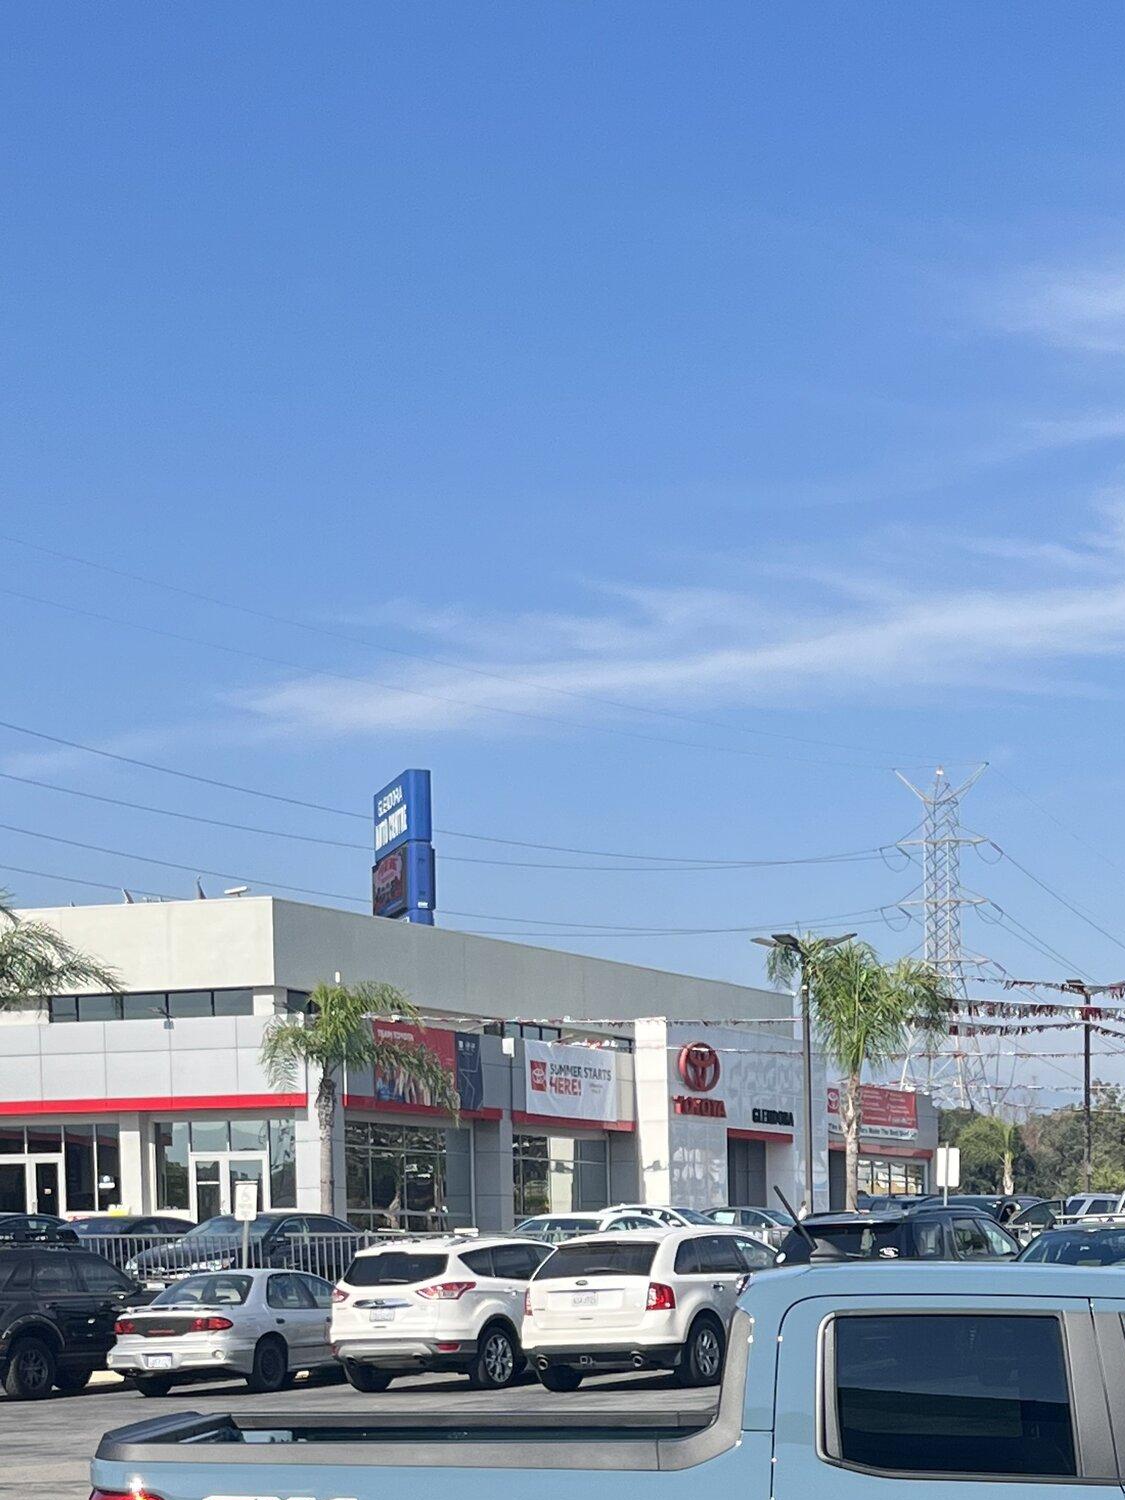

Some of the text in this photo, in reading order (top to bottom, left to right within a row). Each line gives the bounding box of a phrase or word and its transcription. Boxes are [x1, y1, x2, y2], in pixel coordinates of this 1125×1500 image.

[549, 1063, 612, 1082] SUMMER STARTS
[549, 1076, 582, 1096] HERE!
[672, 1095, 727, 1118] TOYOTA
